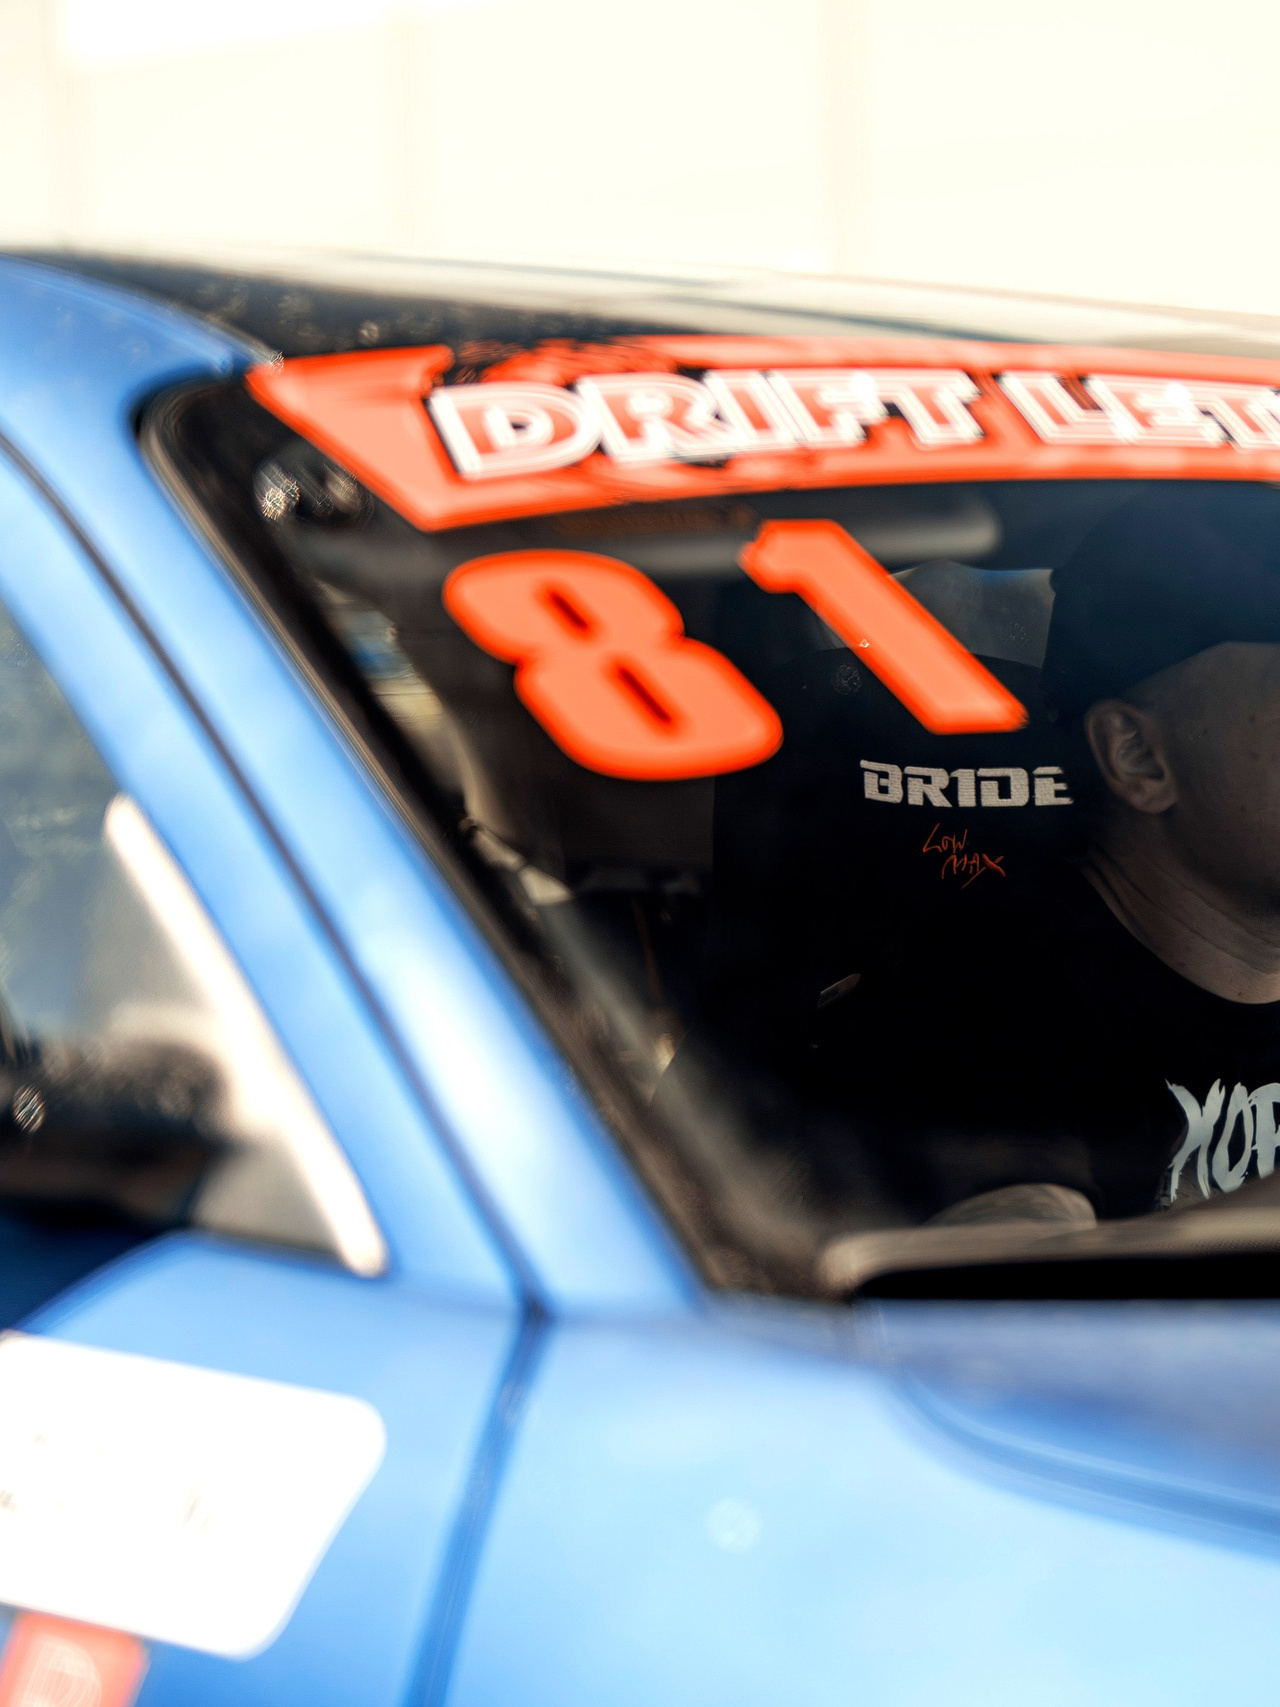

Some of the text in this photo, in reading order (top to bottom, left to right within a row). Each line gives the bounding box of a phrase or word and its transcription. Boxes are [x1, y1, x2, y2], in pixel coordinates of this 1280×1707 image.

[428, 367, 983, 478] DRIFT
[442, 518, 1027, 783] 81
[859, 759, 1074, 808] BRIDE
[941, 853, 1006, 889] MAX
